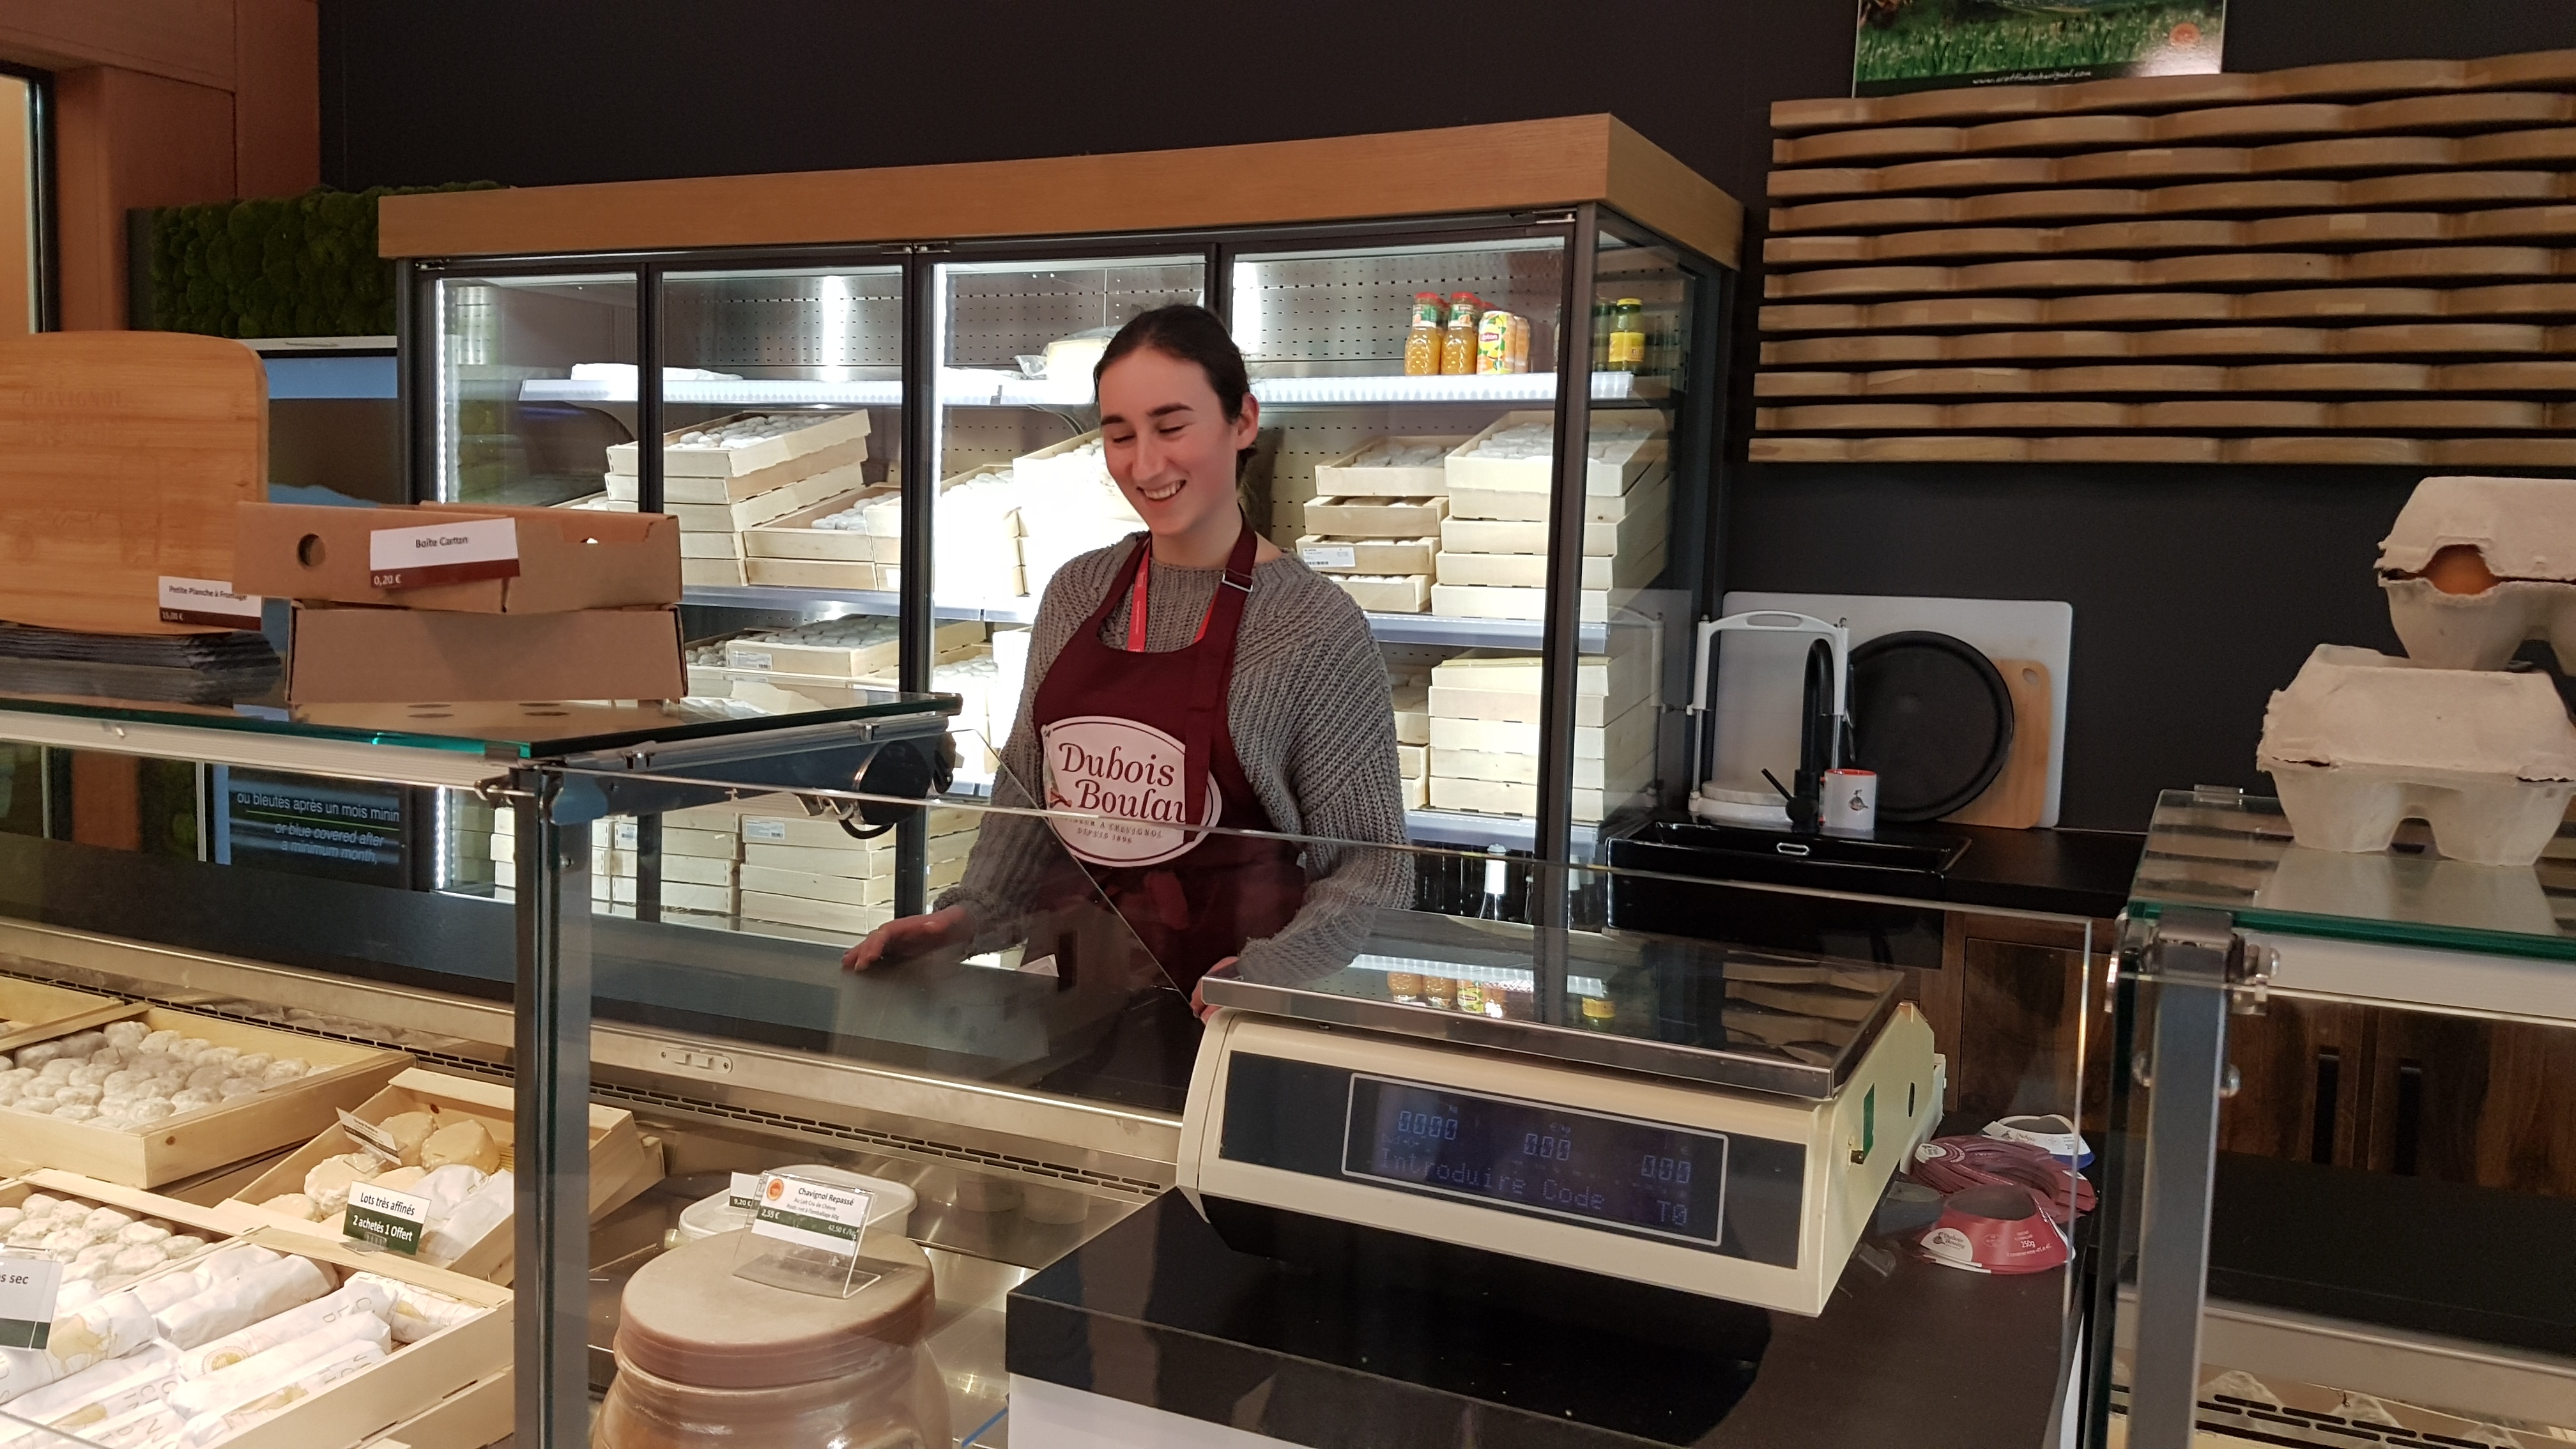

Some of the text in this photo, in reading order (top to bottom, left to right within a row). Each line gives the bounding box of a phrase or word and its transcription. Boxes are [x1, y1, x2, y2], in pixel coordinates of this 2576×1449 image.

[415, 536, 469, 548] Boîte Carton
[395, 574, 401, 583] €
[1058, 742, 1175, 786] Dubois
[237, 792, 250, 804] ou
[253, 793, 290, 809] bleutés
[293, 798, 323, 813] après
[326, 804, 339, 815] un
[341, 804, 367, 818] mois
[275, 823, 385, 847] or blue covered after
[1077, 827, 1132, 844] DEPUIS 1896
[1108, 822, 1163, 839] CHAVIGNOL
[280, 840, 378, 864] a minimum month,
[1382, 1148, 1526, 1195] Introduire
[1542, 1179, 1604, 1209] Code
[360, 1192, 415, 1216] Lots très affinés
[798, 1188, 854, 1206] Chavignol Repassé
[353, 1215, 413, 1242] 2 achetés 1 Offert
[2021, 1240, 2035, 1248] 250g
[9, 1275, 29, 1285] sec
